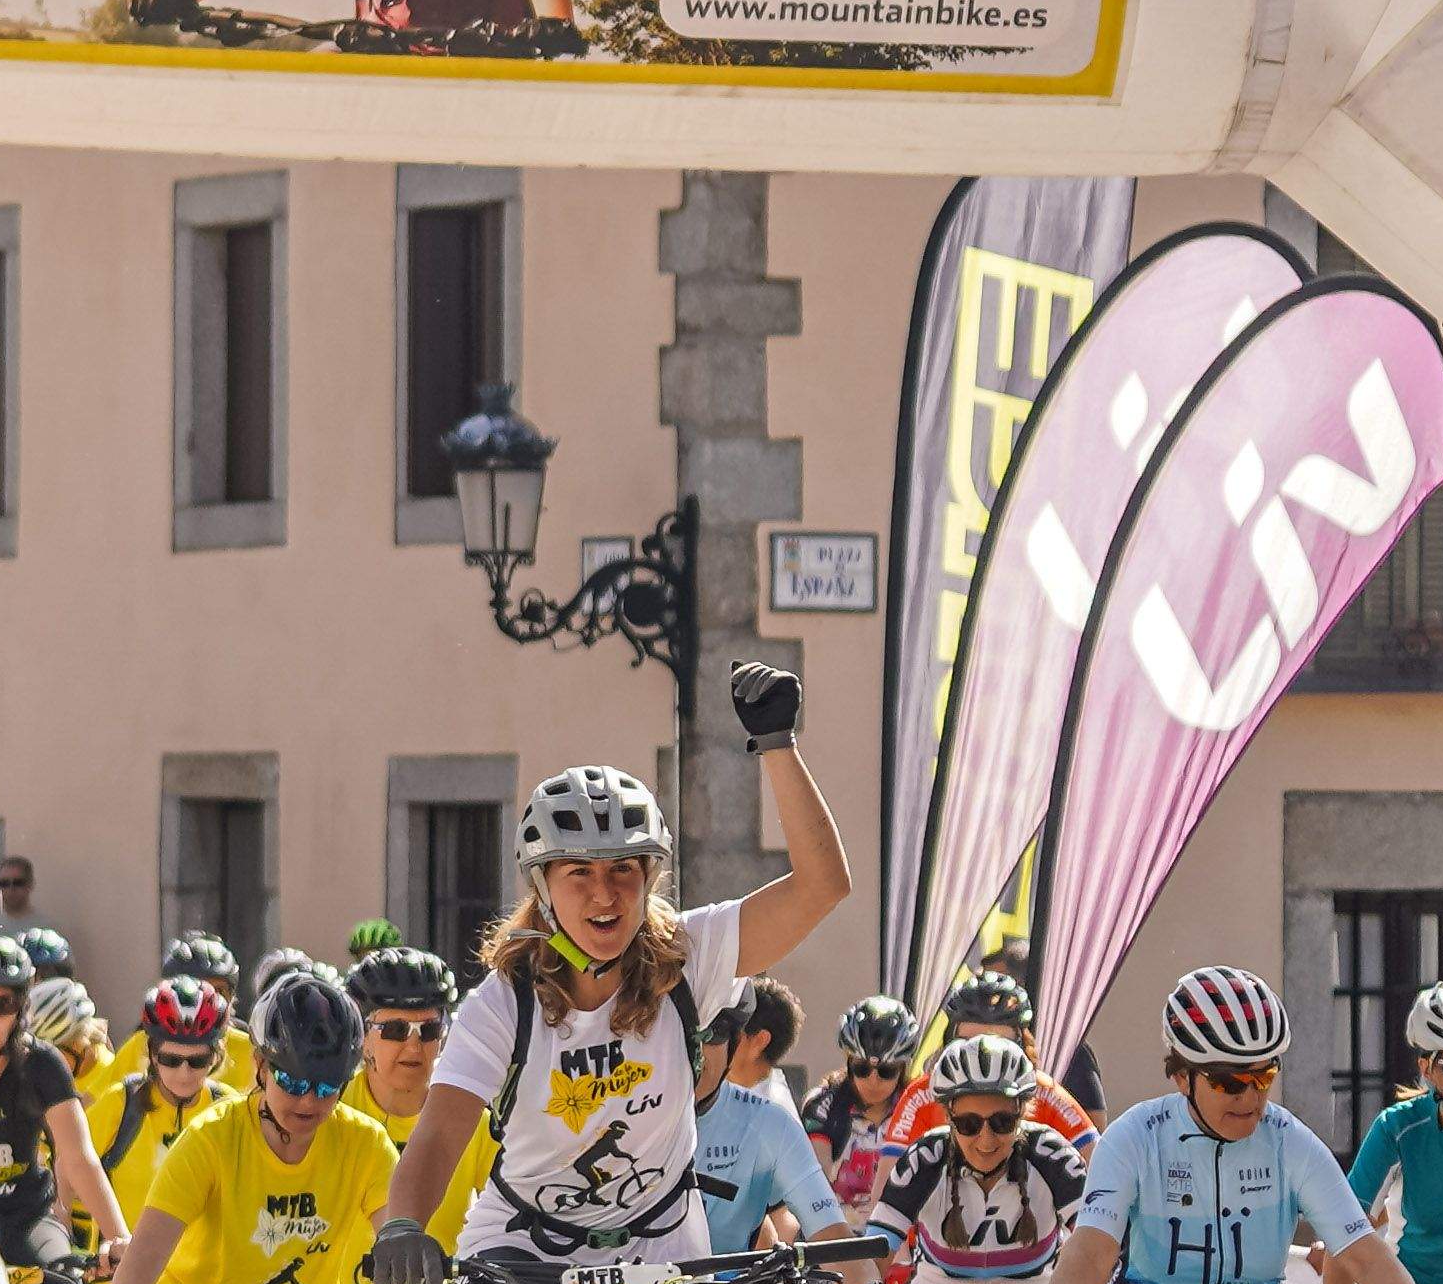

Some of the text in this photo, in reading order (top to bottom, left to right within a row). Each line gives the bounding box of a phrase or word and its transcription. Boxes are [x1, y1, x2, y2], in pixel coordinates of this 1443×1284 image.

[561, 1039, 625, 1082] MTB
[587, 1067, 649, 1100] Mujer
[625, 1093, 663, 1116] Liv
[267, 1192, 317, 1218] MTB
